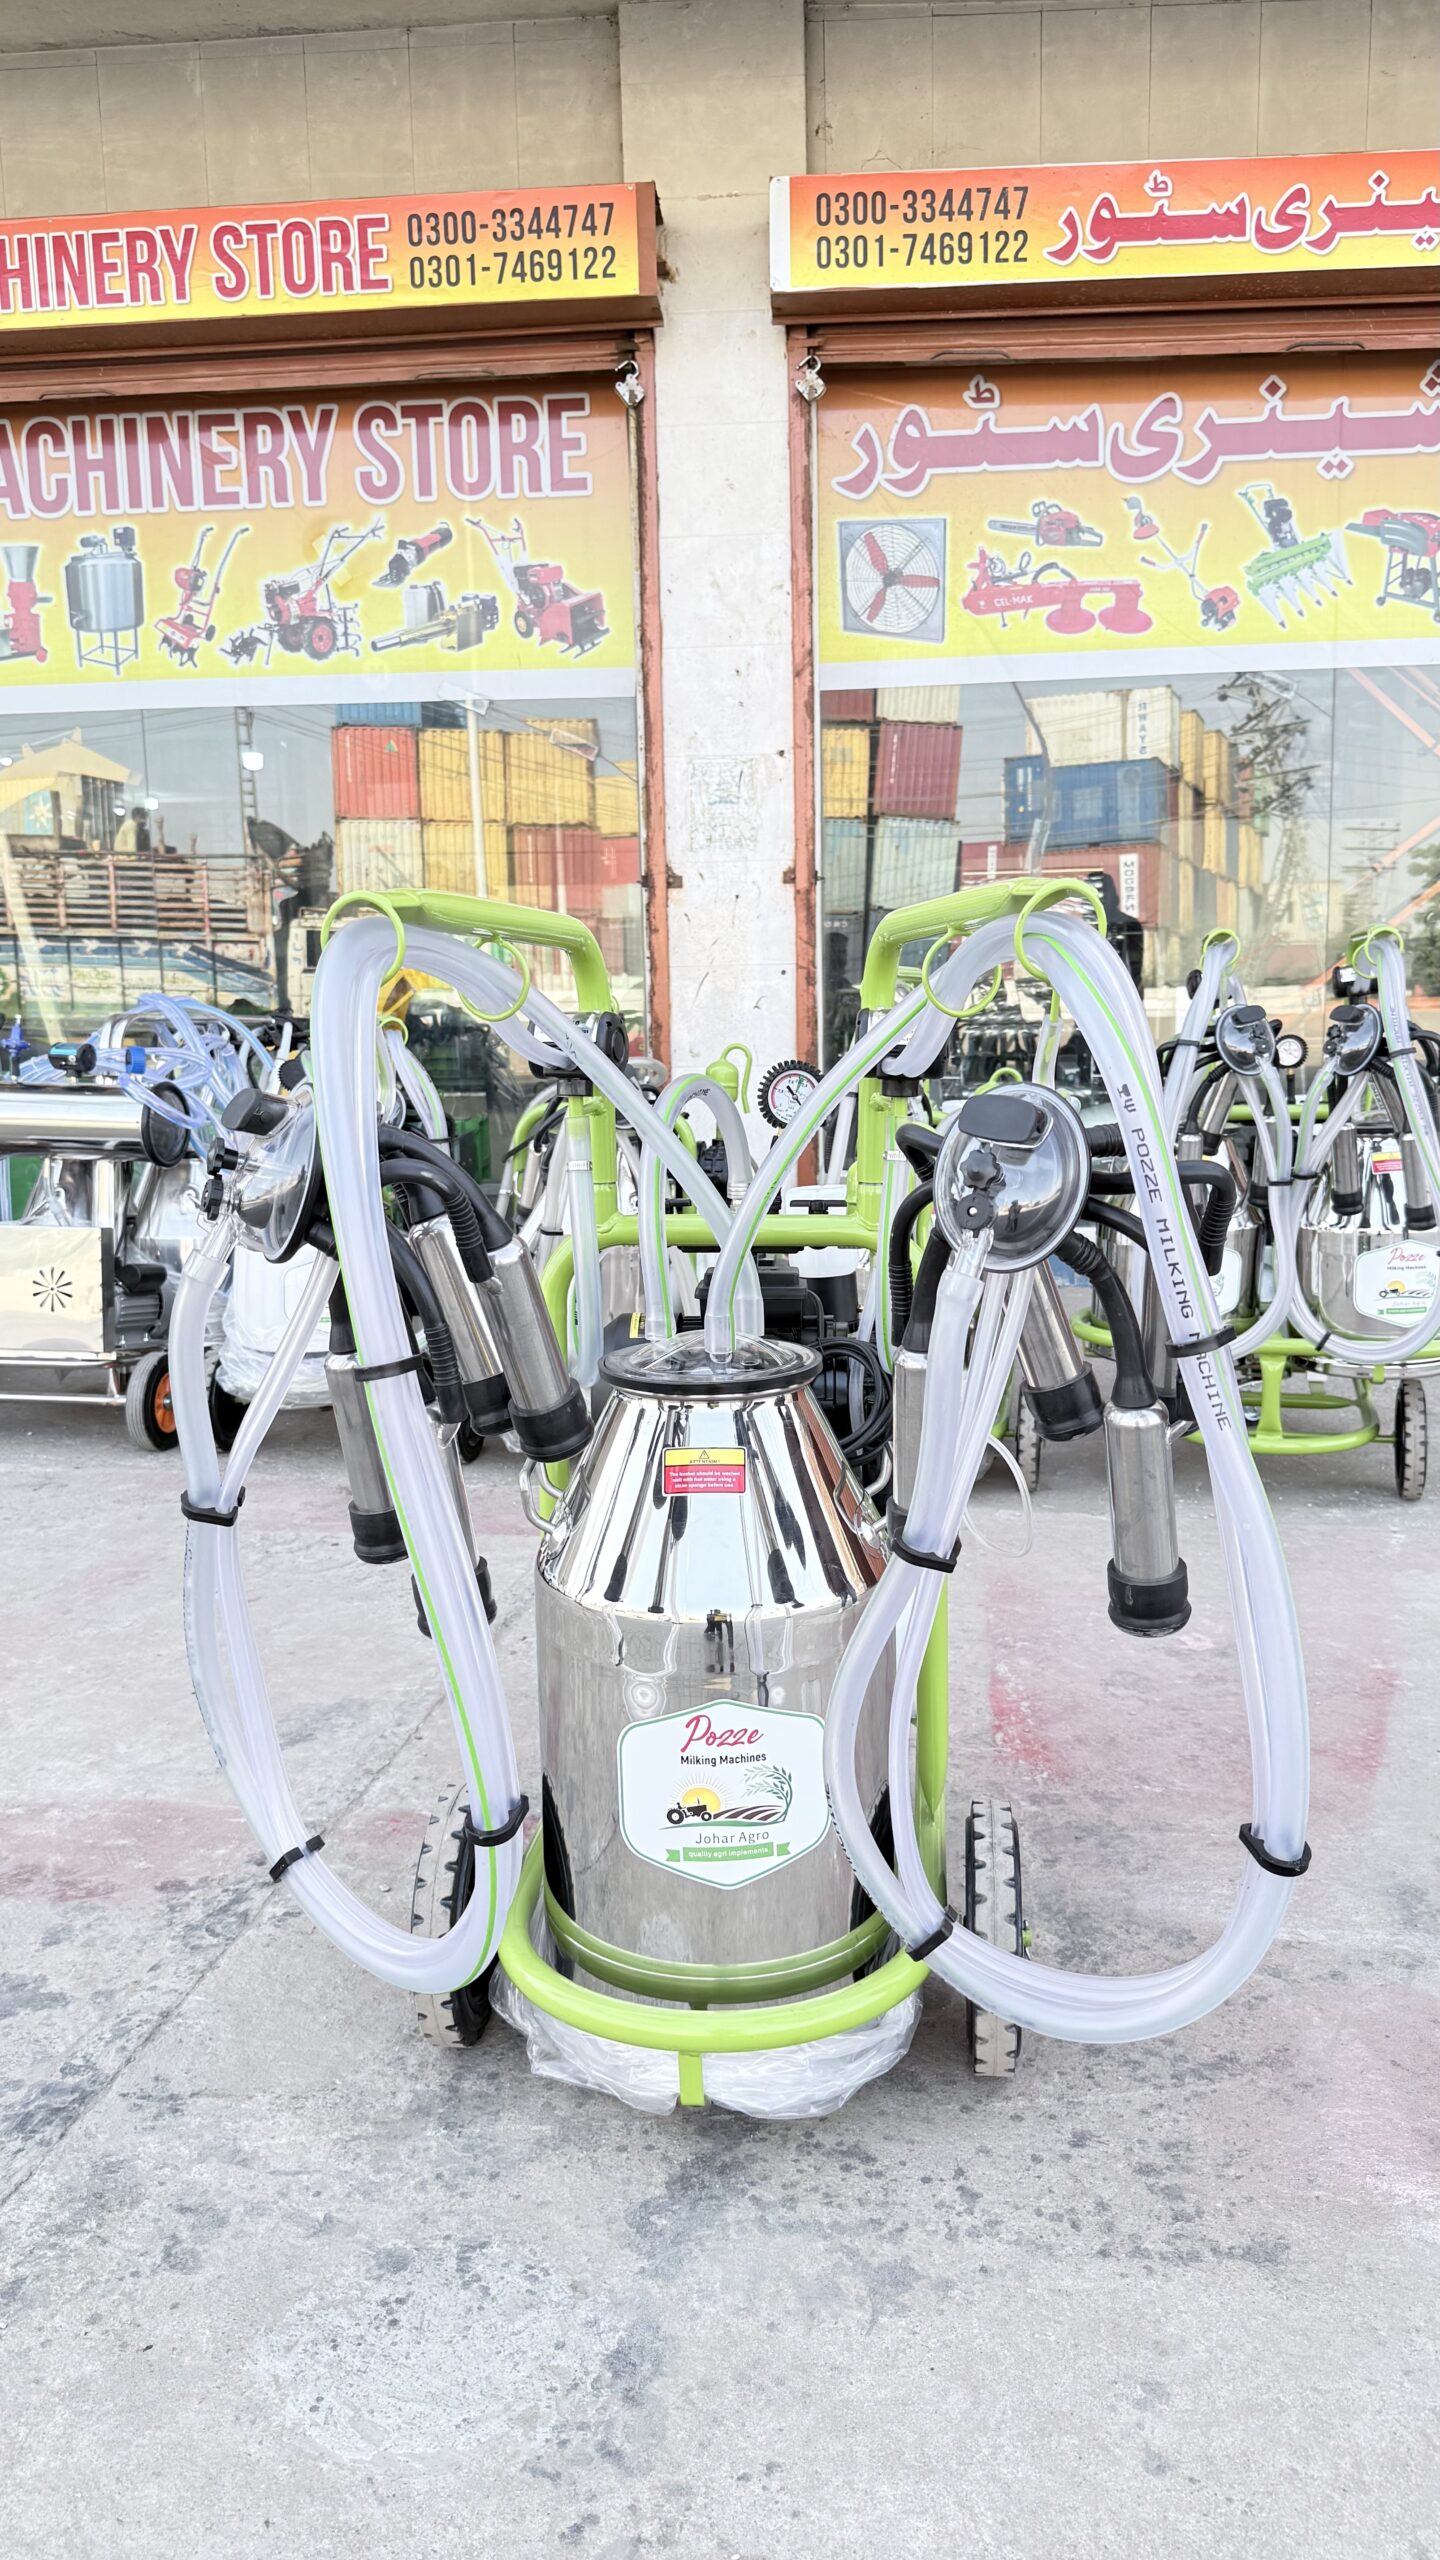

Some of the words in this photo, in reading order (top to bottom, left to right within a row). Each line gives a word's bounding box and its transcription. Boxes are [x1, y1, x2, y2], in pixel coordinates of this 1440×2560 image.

[407, 202, 614, 247] 0300-3344747
[816, 186, 1029, 226] 0300-3344747
[1046, 172, 1249, 261] سٹور
[211, 216, 392, 300] STORE
[409, 245, 616, 289] 0301-7469122
[816, 229, 1029, 269] 0301-7469122
[356, 396, 591, 501] STORE
[833, 376, 1104, 498] سٹور
[1131, 1128, 1163, 1203] POZZE
[1156, 1218, 1195, 1319] MILKING
[680, 1714, 764, 1753] Pozze
[680, 1754, 717, 1767] Milking
[719, 1752, 767, 1765] Machines
[688, 1850, 712, 1859] quality
[713, 1850, 727, 1858] agri
[728, 1847, 769, 1857] implements
[695, 1832, 735, 1845] Johar
[738, 1831, 770, 1844] Agro
